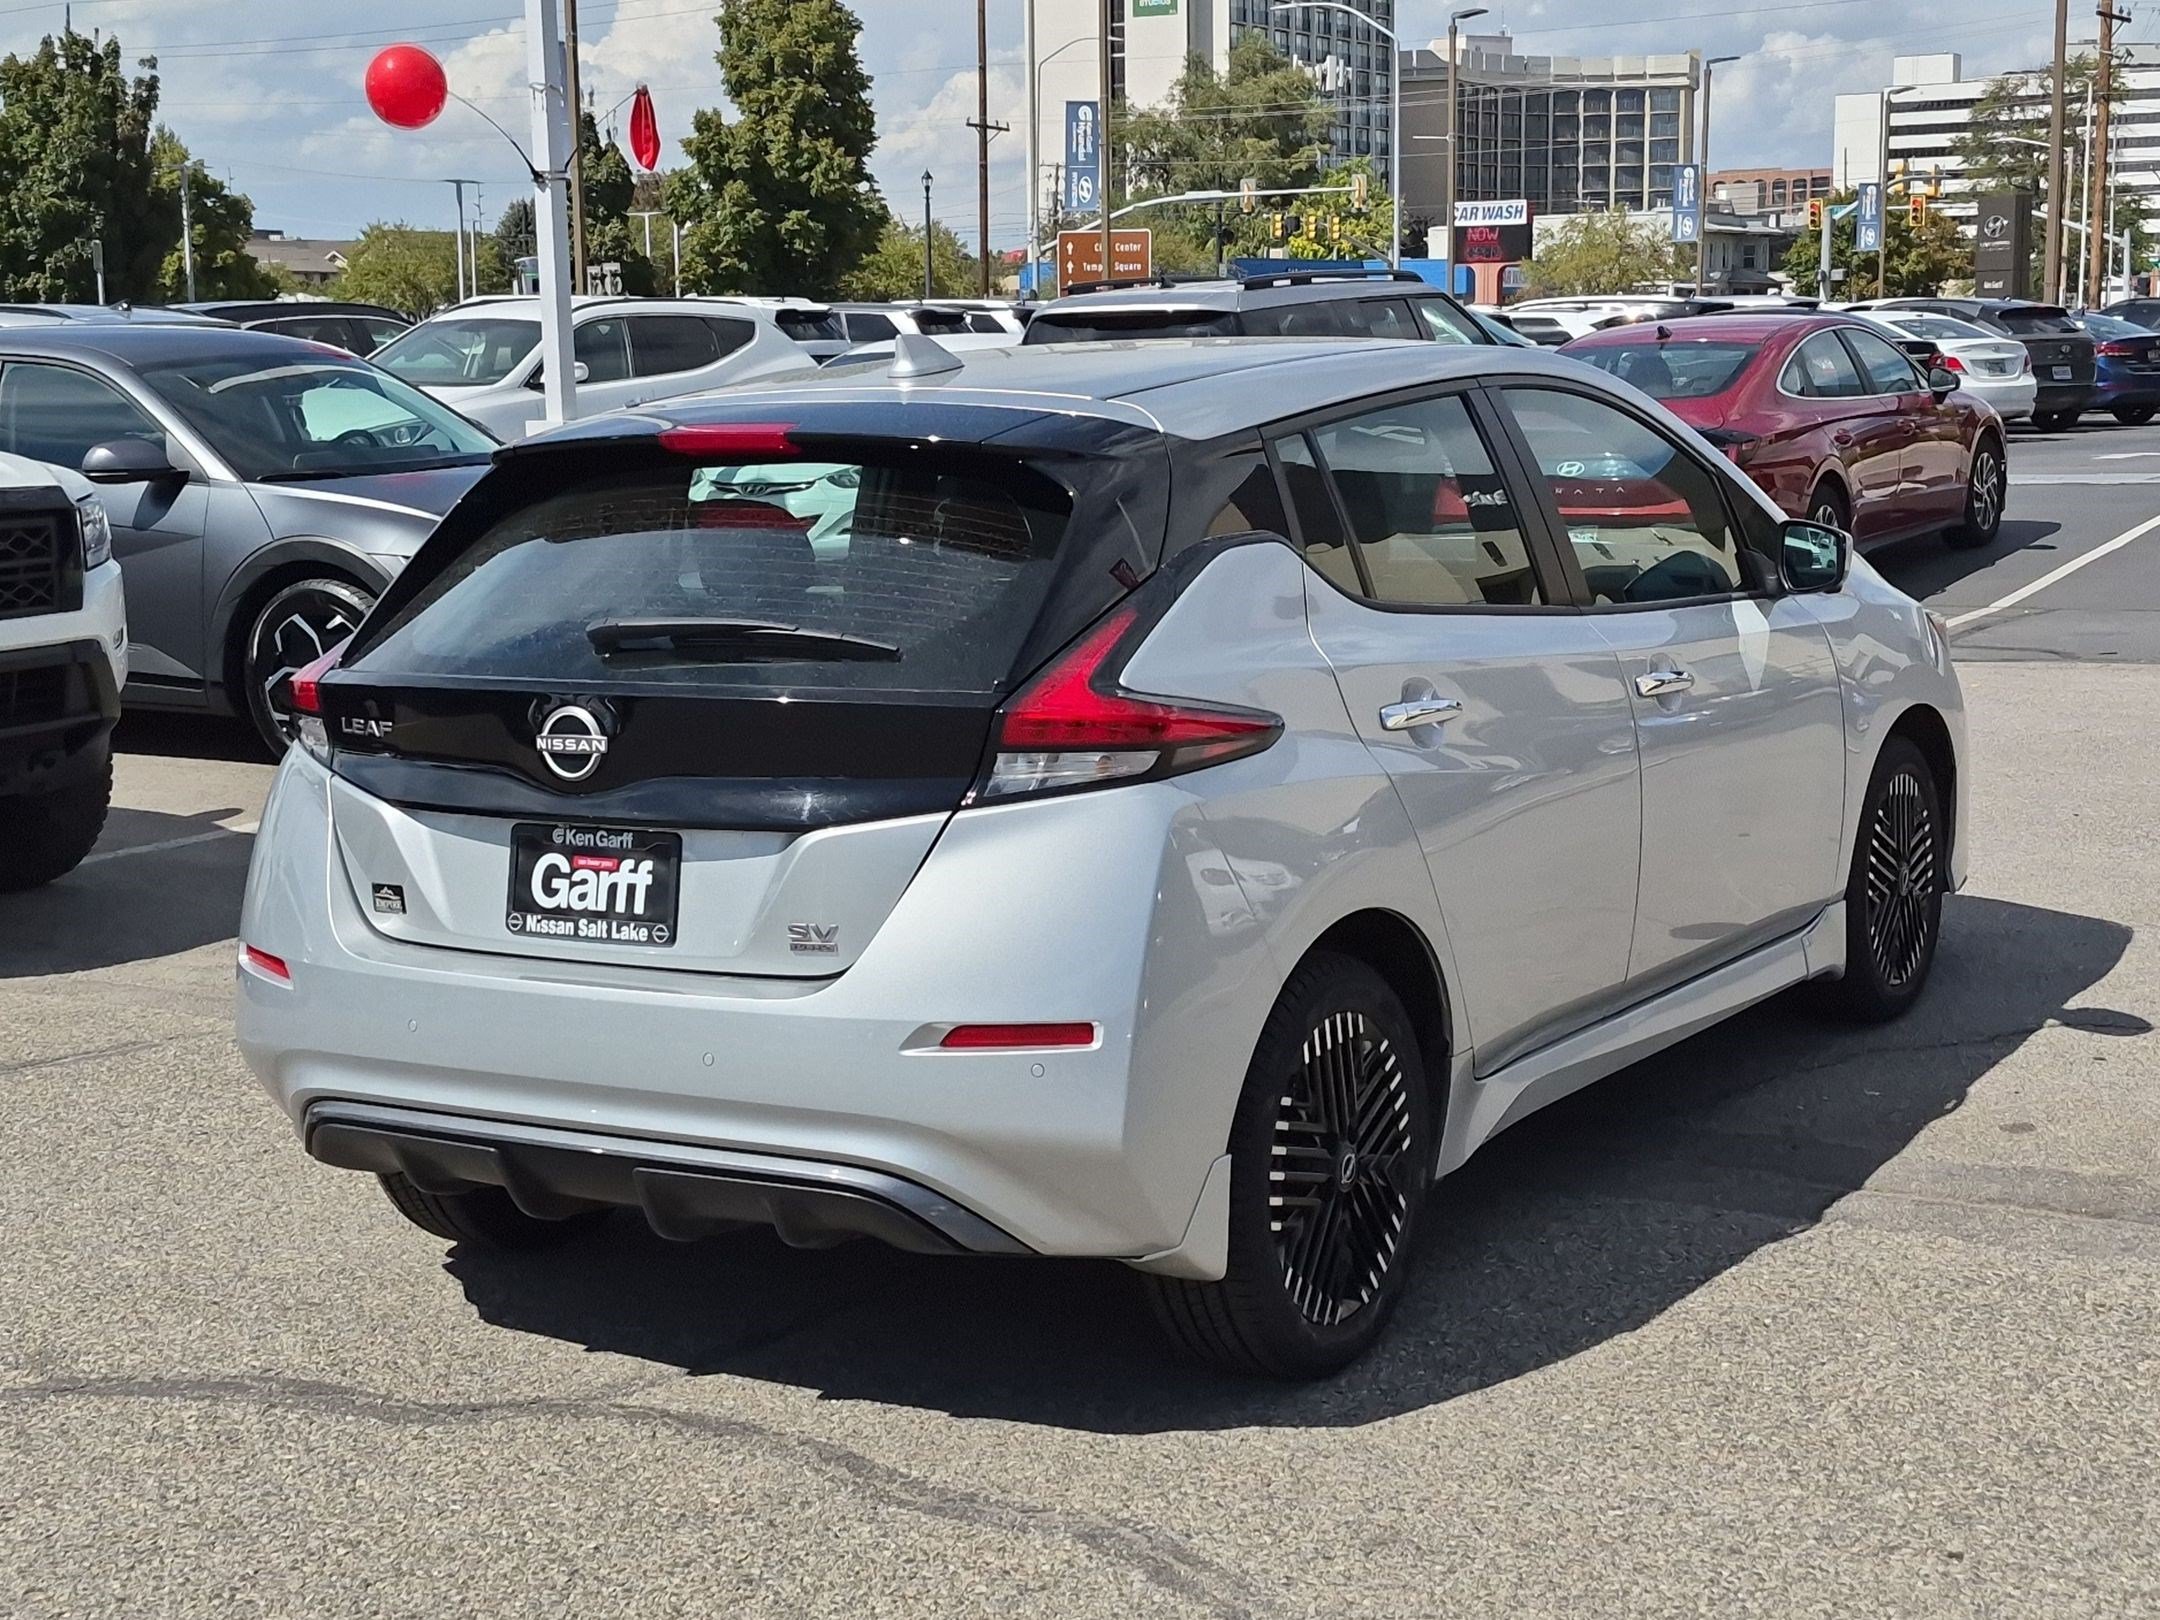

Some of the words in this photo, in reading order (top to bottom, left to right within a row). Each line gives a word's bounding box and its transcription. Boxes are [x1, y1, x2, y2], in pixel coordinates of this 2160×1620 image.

[1481, 204, 1524, 220] WASH
[1467, 227, 1500, 241] NOW
[1115, 242, 1142, 252] Center
[1083, 262, 1103, 272] Temp
[1114, 261, 1142, 272] Square
[341, 716, 393, 738] LEAF
[537, 737, 606, 752] NISSAN
[566, 828, 594, 846] Ken
[596, 830, 633, 849] Garff
[531, 852, 654, 915] Garff
[526, 914, 574, 936] Nissan
[578, 918, 608, 939] Salt
[611, 921, 649, 942] Lake
[787, 923, 839, 943] SV
